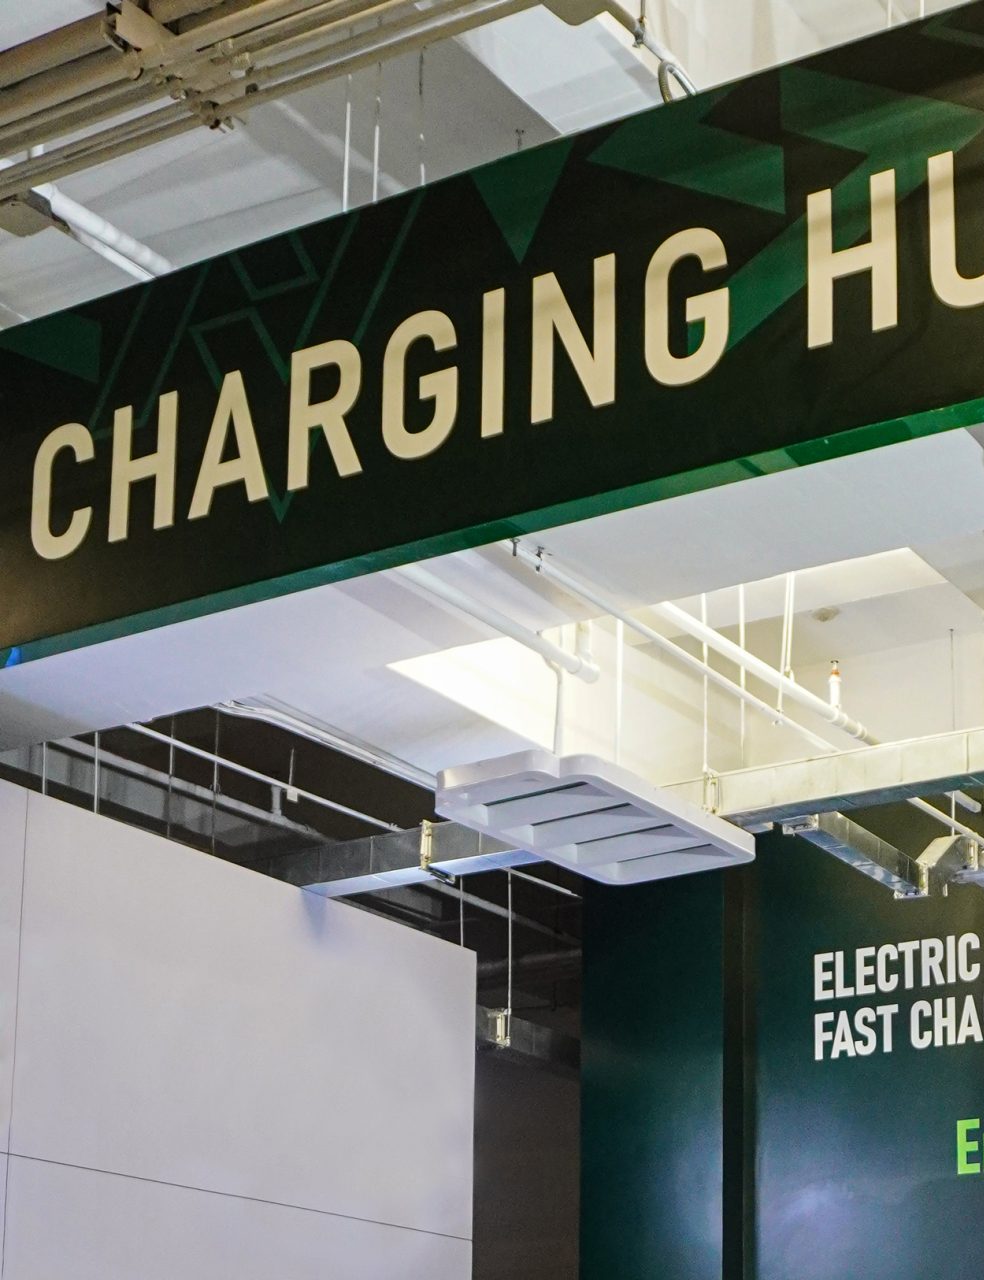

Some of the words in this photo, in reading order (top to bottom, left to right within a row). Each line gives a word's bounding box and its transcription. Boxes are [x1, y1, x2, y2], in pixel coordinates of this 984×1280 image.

[30, 228, 729, 560] CHARGING
[814, 933, 980, 1001] ELECTRIC
[814, 1004, 898, 1061] FAST
